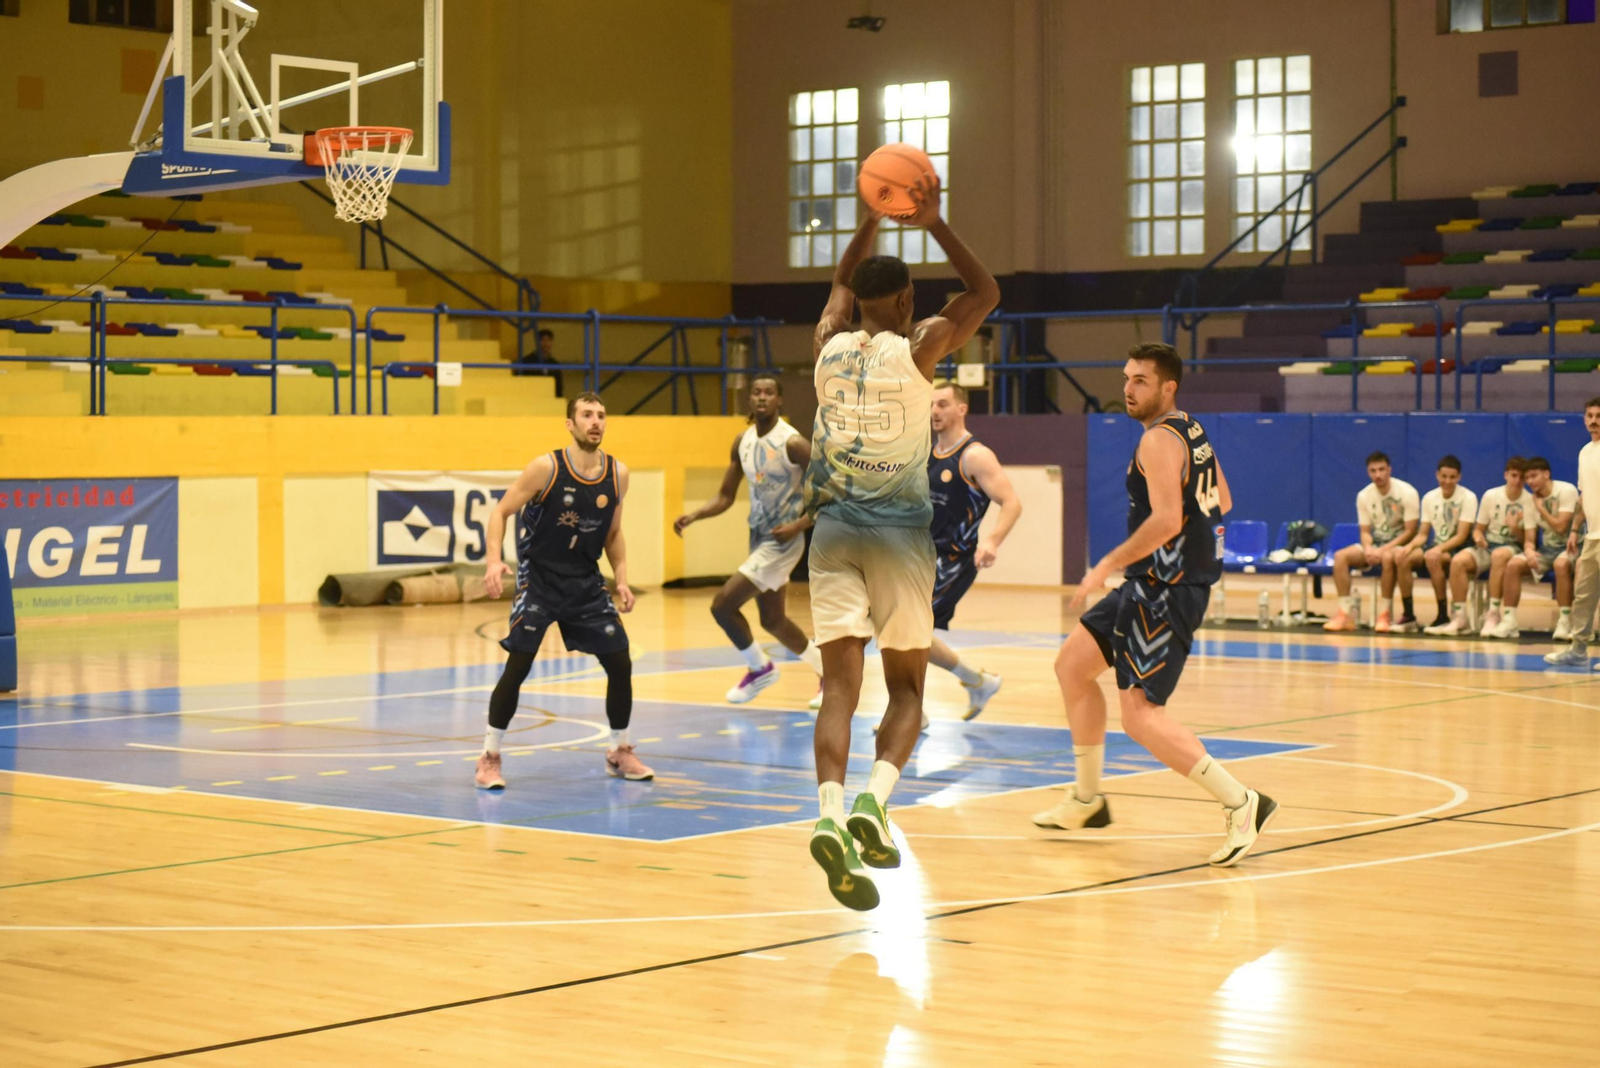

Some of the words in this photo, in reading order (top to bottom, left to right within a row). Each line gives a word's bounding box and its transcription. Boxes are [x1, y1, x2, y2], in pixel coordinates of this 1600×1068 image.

[823, 376, 906, 445] 35
[568, 534, 578, 549] 1
[33, 596, 73, 609] Material
